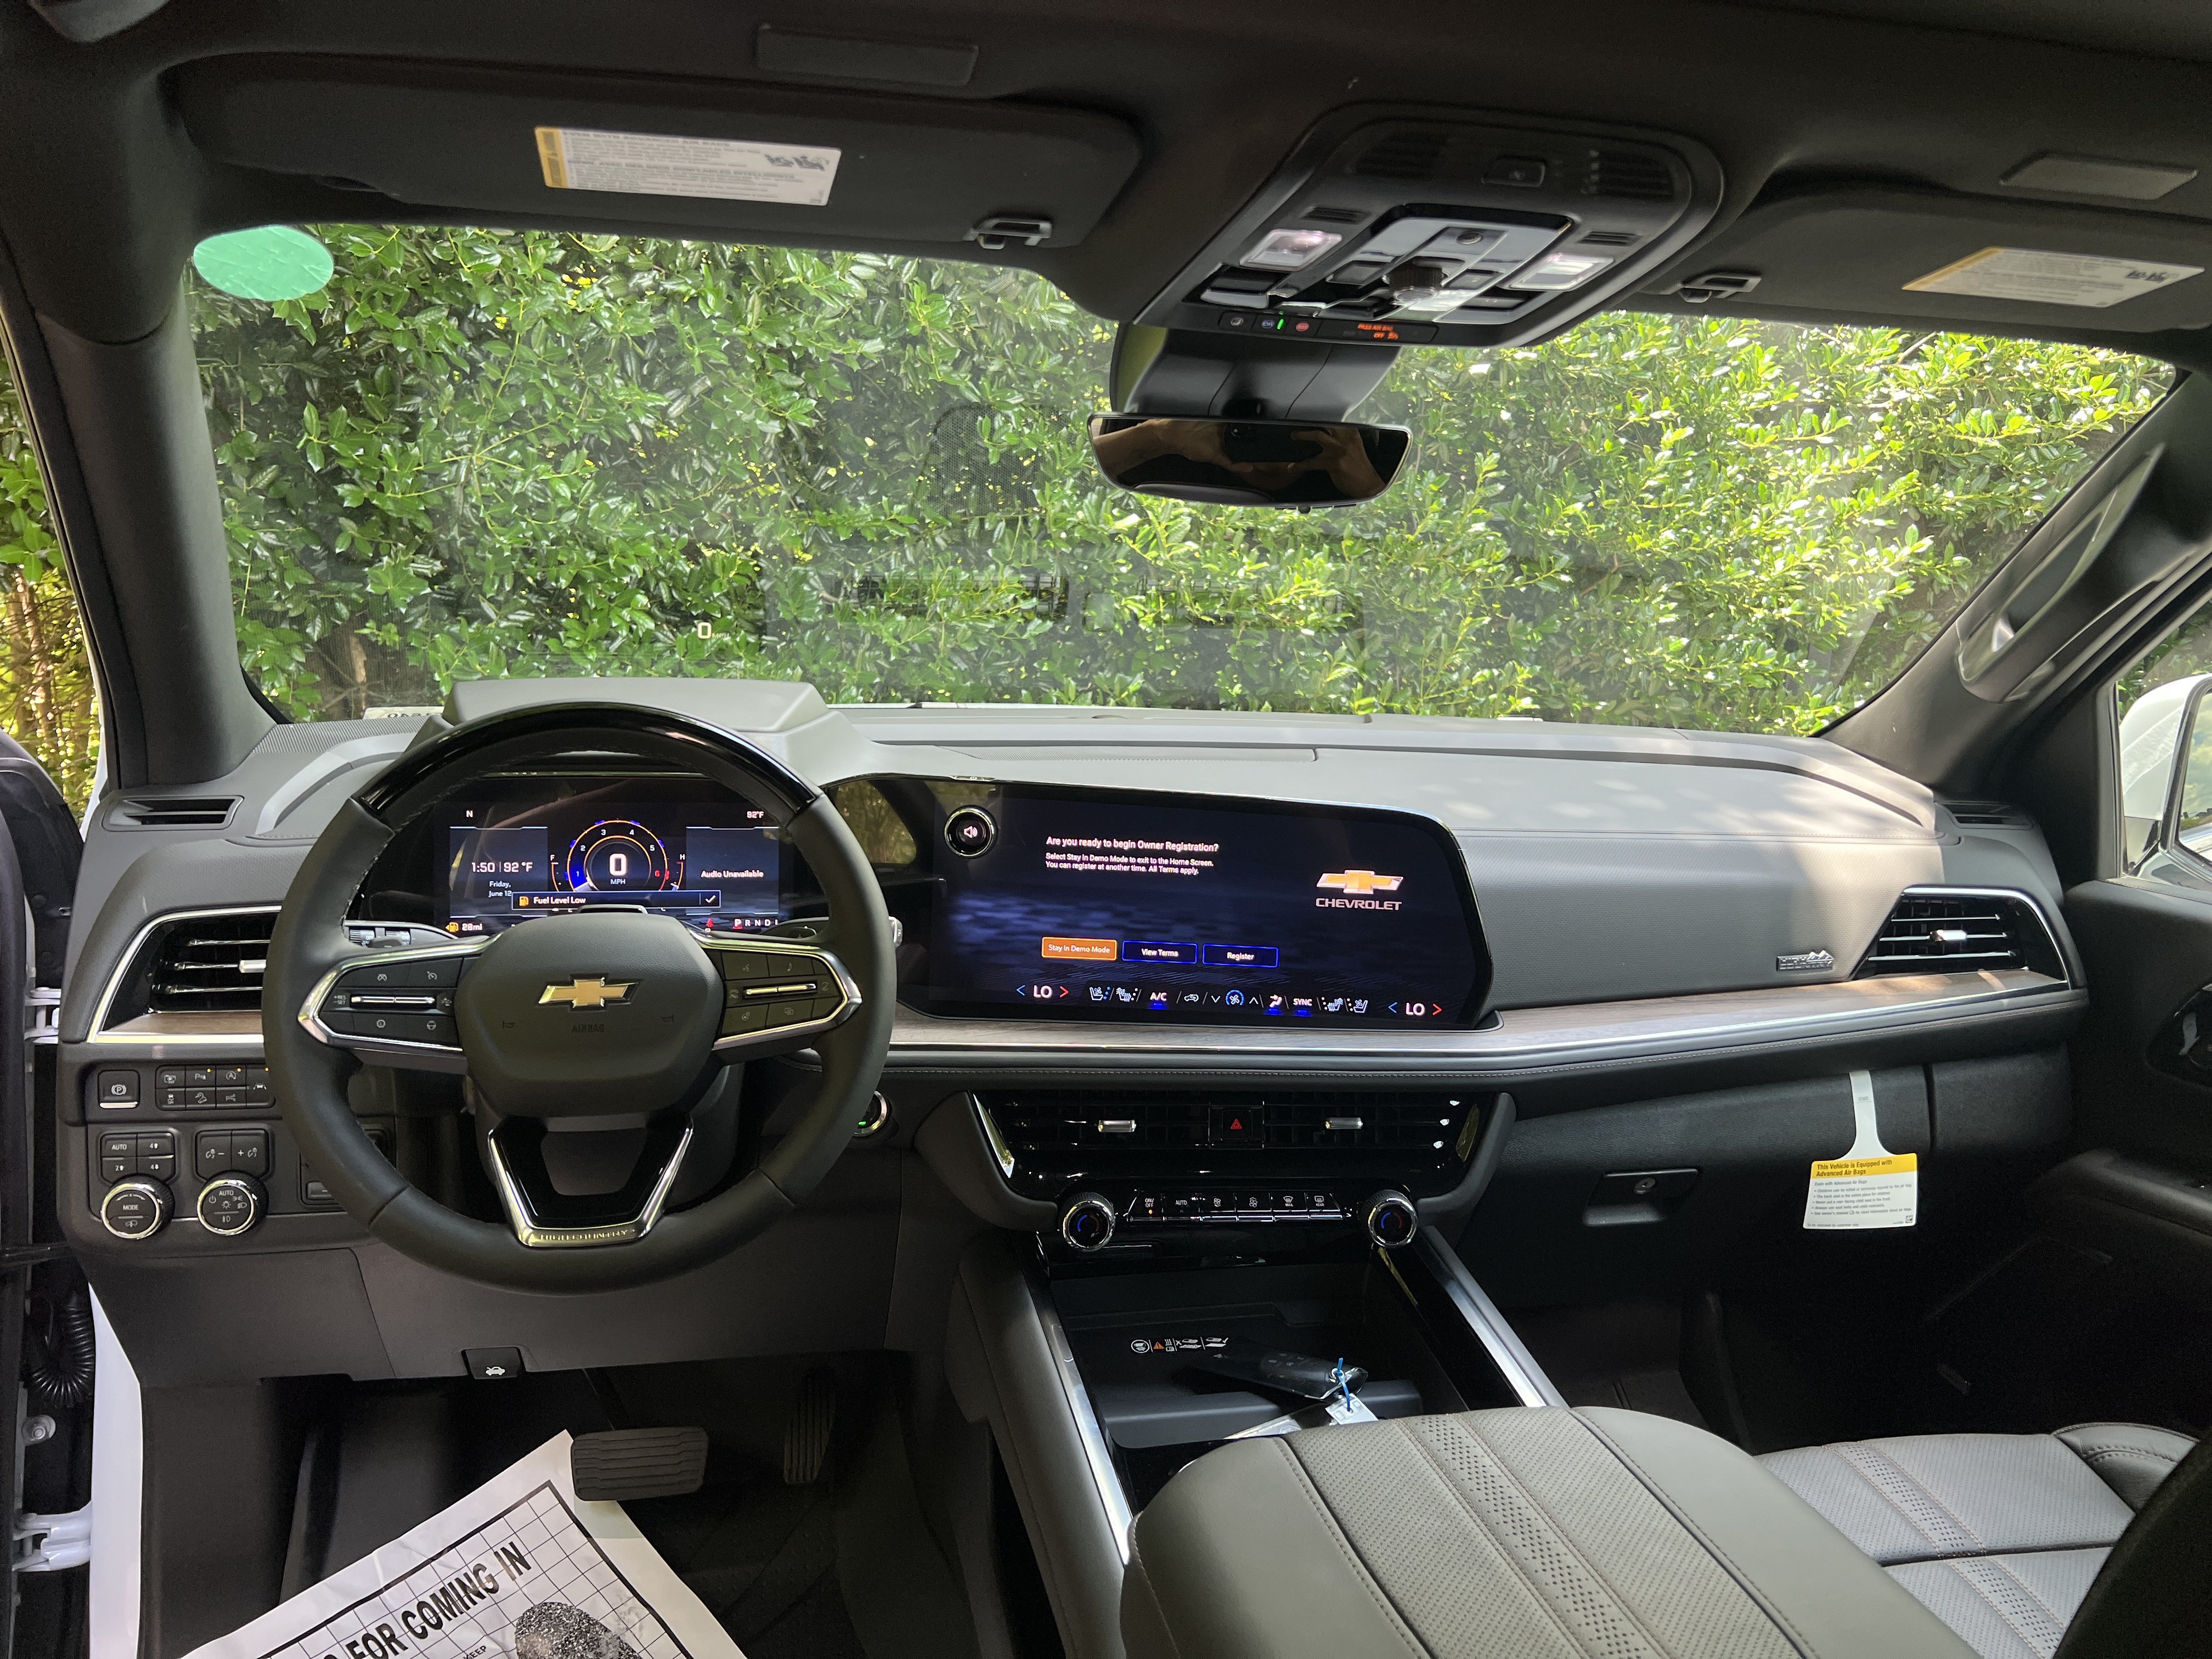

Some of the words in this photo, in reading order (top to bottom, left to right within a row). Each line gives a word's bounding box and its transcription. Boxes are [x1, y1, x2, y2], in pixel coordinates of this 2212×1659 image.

[1046, 837, 1060, 845] Are
[1062, 839, 1077, 847] you
[1079, 838, 1102, 849] ready
[1103, 839, 1112, 848] to
[1113, 839, 1136, 850] begin
[1137, 840, 1165, 850] Owner
[1165, 841, 1220, 853] Registration?
[609, 853, 627, 876] 0
[1046, 852, 1066, 860] Select
[1066, 853, 1081, 862] Stay
[1190, 859, 1215, 867] Screen.
[471, 862, 495, 873] 1:50
[503, 862, 519, 873] 92
[1072, 862, 1097, 871] register
[1131, 864, 1147, 872] time.
[1148, 865, 1157, 873] All
[1158, 865, 1179, 873] Terms
[1180, 866, 1200, 876] apply.
[723, 870, 764, 878] Unavailable
[489, 881, 511, 889] Friday,
[1316, 898, 1402, 911] CHEVROLET
[734, 918, 742, 927] P
[1048, 944, 1063, 953] Stay
[1070, 945, 1090, 953] Demo
[1141, 948, 1157, 957] View
[1158, 949, 1178, 957] Terms
[1227, 951, 1255, 961] Register
[1033, 986, 1053, 998] LO
[1150, 992, 1167, 1001] A/C
[1293, 998, 1312, 1006] SYNC
[1406, 1002, 1425, 1016] LO
[345, 1623, 408, 1659] FOR
[402, 1563, 500, 1639] COMING
[494, 1541, 532, 1582] IN
